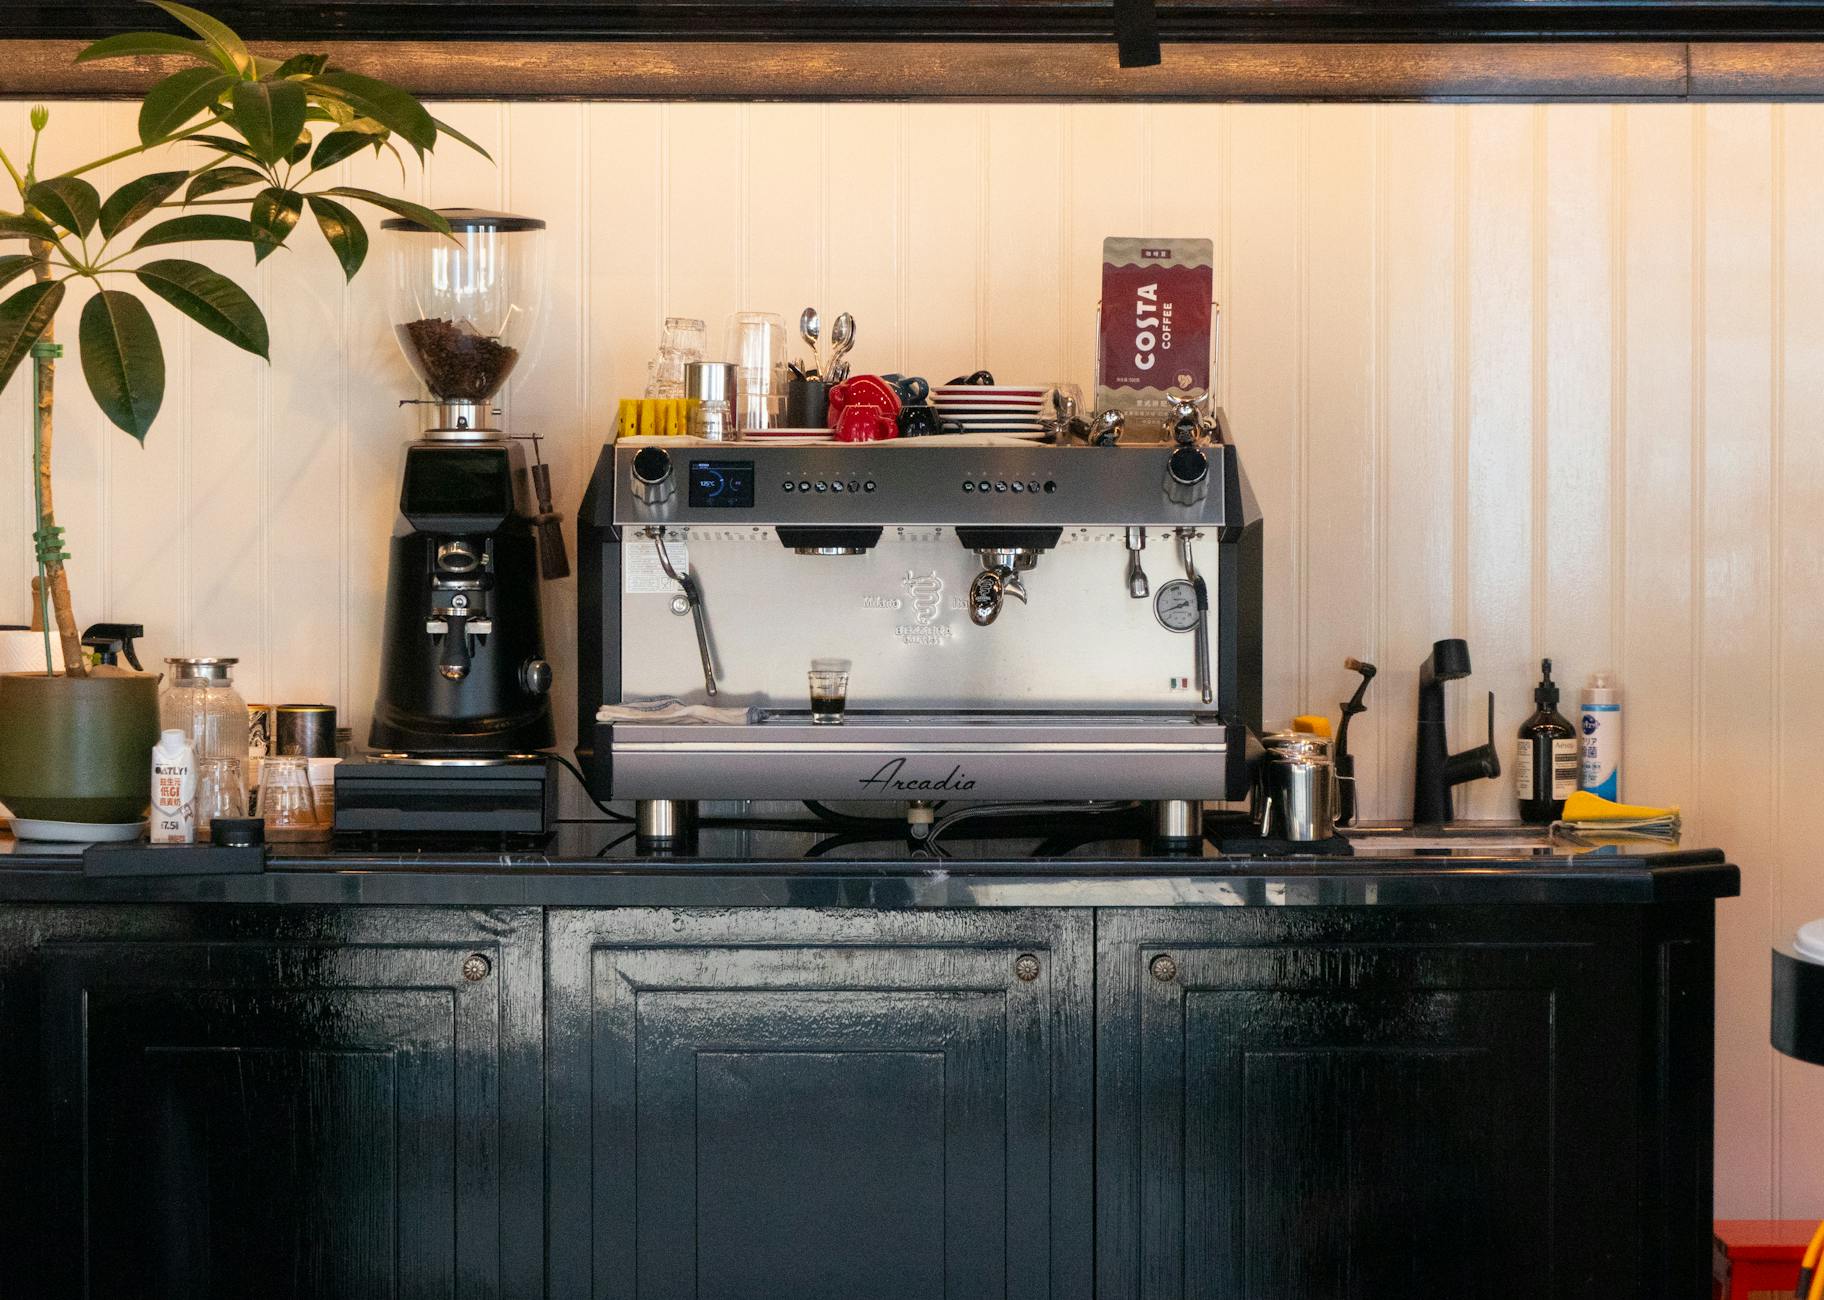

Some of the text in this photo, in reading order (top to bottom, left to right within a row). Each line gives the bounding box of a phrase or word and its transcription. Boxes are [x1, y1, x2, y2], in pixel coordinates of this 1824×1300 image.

[1134, 283, 1159, 371] COSTA
[1161, 302, 1173, 350] COFFEE
[863, 596, 901, 609] Milano
[155, 766, 188, 775] OATLY!
[858, 757, 976, 793] Arcadia
